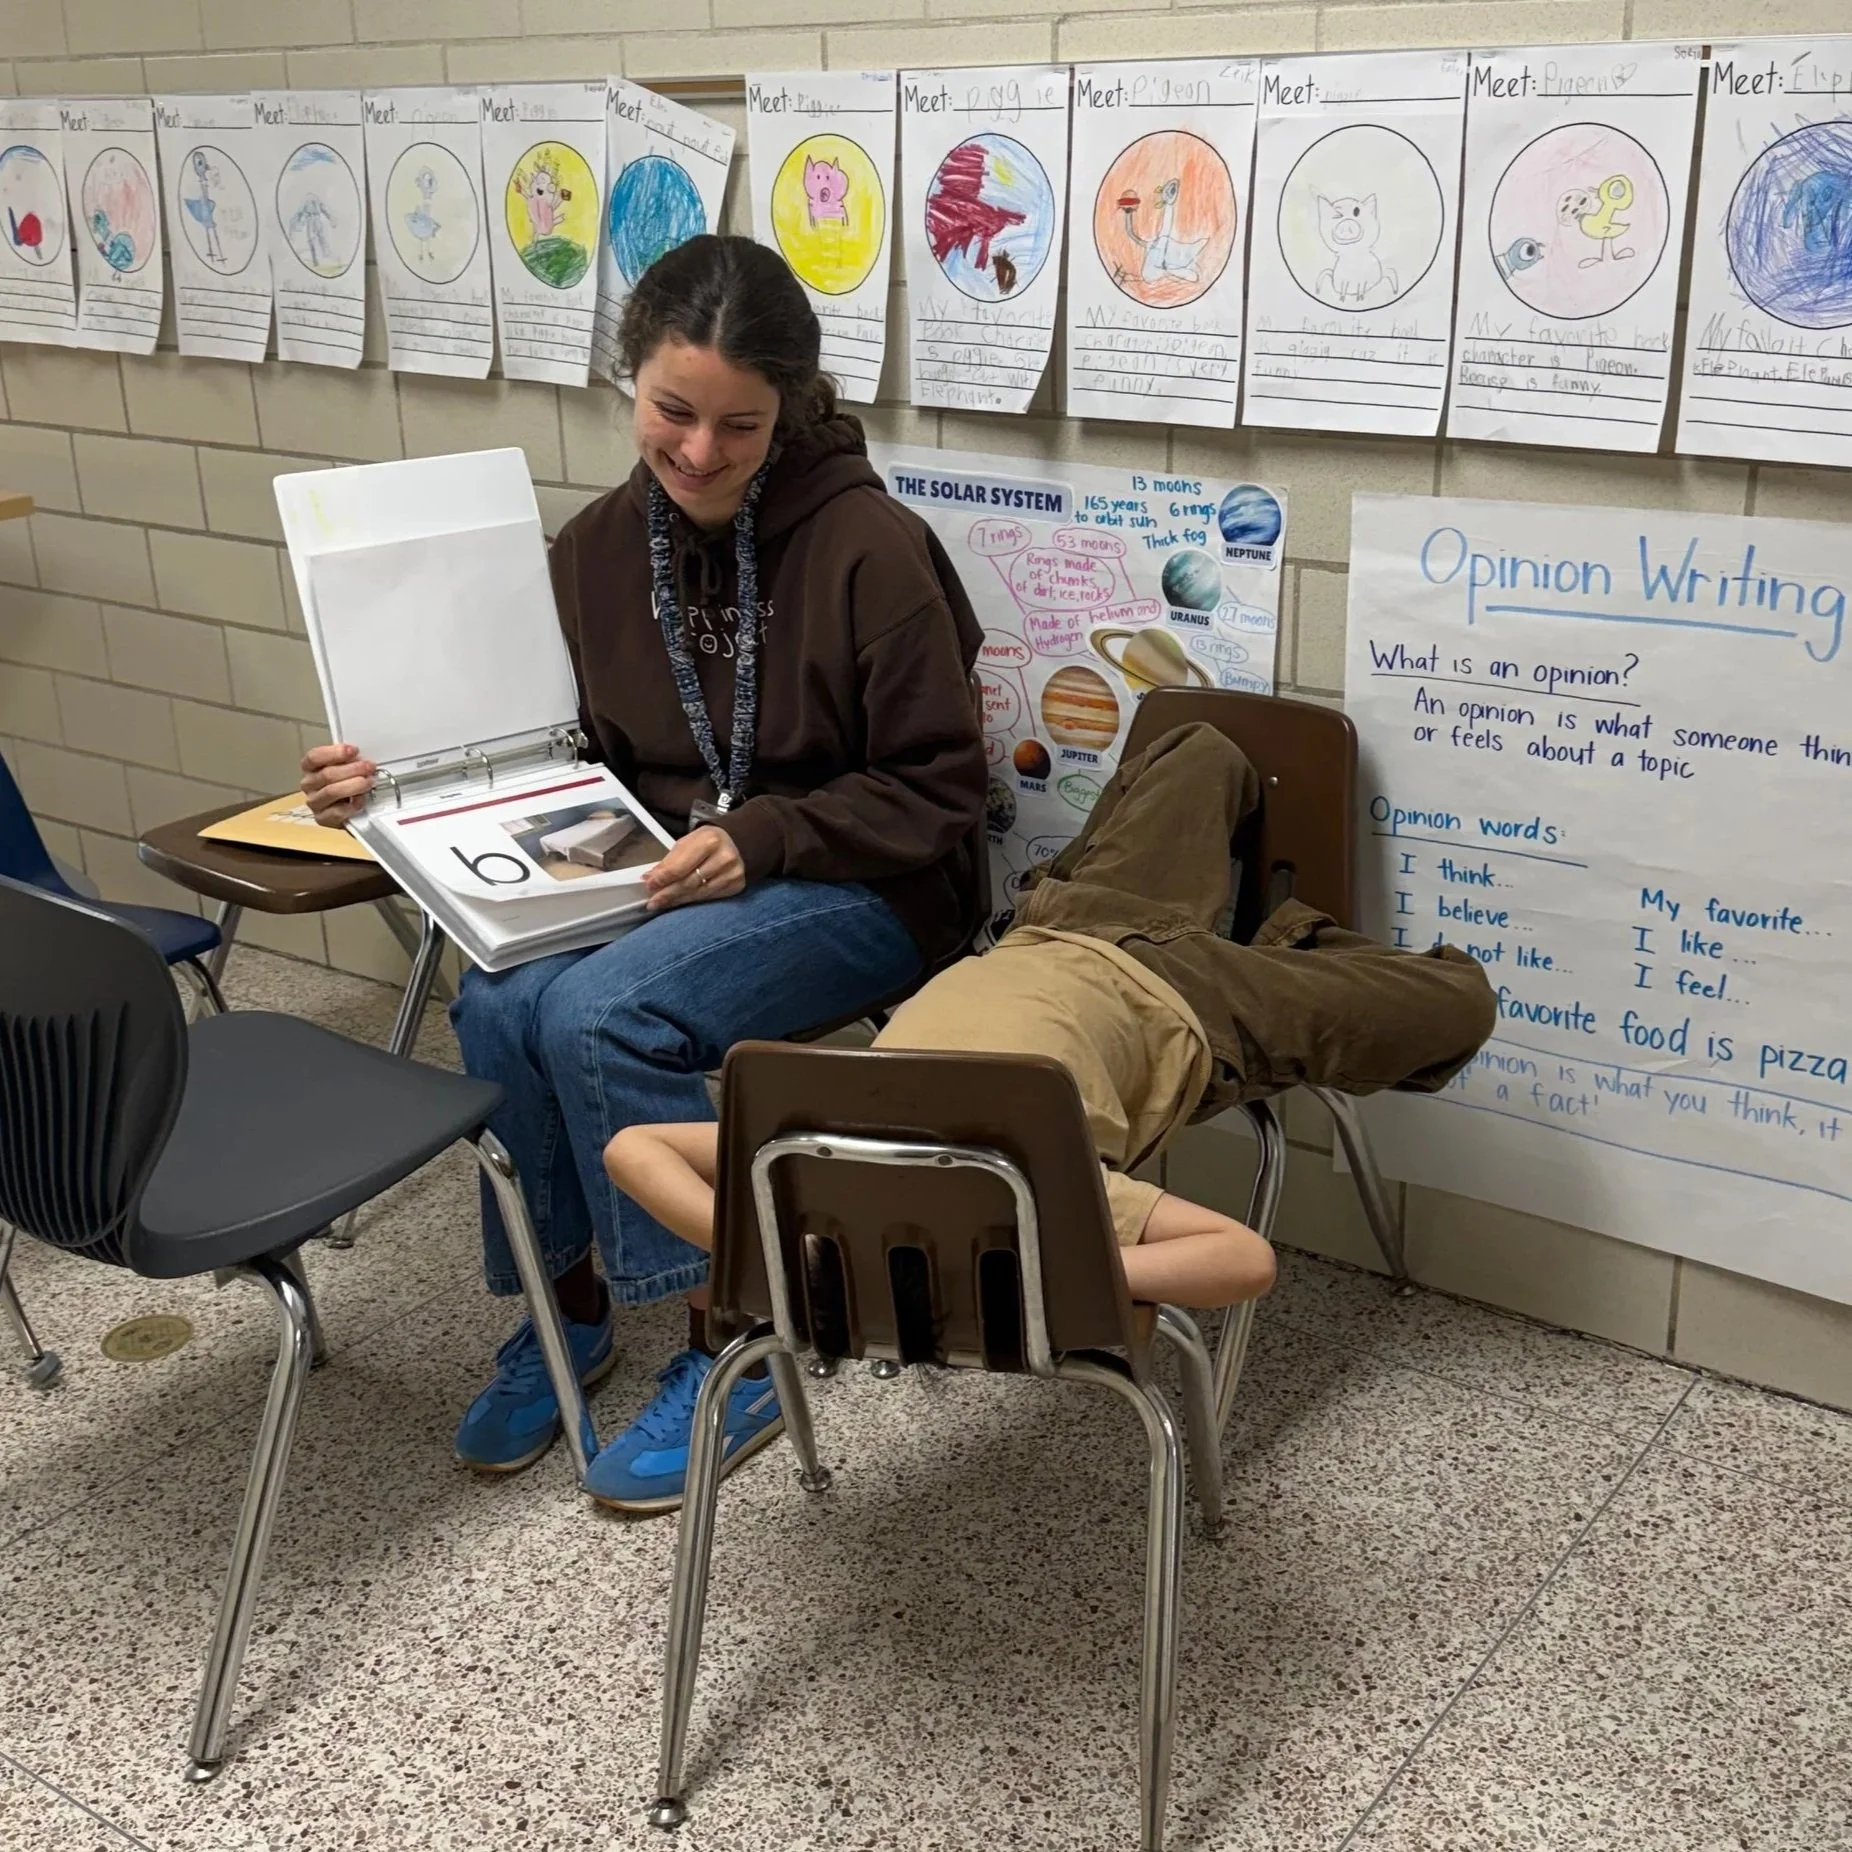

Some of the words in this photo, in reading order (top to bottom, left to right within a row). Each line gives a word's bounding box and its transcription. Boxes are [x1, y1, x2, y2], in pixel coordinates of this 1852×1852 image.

[1264, 74, 1320, 105] Meet:
[1473, 65, 1537, 98] Meet:
[1713, 61, 1783, 95] Meet:
[606, 86, 645, 123] Meet:
[749, 86, 793, 113] Meet:
[904, 84, 952, 113] Meet:
[1077, 78, 1128, 108] Meet:
[254, 103, 288, 125] Meet:
[365, 101, 399, 124] Meet:
[482, 98, 519, 122] Meet:
[1470, 311, 1513, 339] My
[895, 476, 926, 497] THE
[930, 480, 987, 503] SOLAR
[990, 487, 1063, 513] SYSTEM
[1132, 476, 1147, 491] 13
[1153, 479, 1202, 496] moons
[1084, 496, 1107, 511] 165
[1111, 499, 1148, 513] years
[1169, 502, 1178, 517] 6
[1183, 501, 1217, 525] rings
[1075, 511, 1088, 524] to
[1095, 511, 1124, 526] orbit
[1130, 516, 1158, 529] sun
[977, 526, 986, 548] 7
[990, 526, 1024, 547] rings
[1056, 534, 1077, 549] 53
[1081, 539, 1122, 554] moons
[1142, 532, 1178, 550] Thick
[1185, 529, 1207, 546] fog
[1026, 553, 1059, 574] Rings
[1064, 557, 1097, 572] made
[1226, 546, 1272, 561] NEPTUNE
[1016, 581, 1027, 593] of
[1029, 568, 1043, 581] of
[1049, 571, 1096, 588] chunks
[1421, 526, 1612, 625] Opinion
[1639, 535, 1847, 663] Writing
[1029, 614, 1061, 631] Made
[1068, 613, 1080, 627] of
[1089, 605, 1134, 623] helium
[1137, 599, 1158, 615] and
[1170, 610, 1210, 626] URANUS
[1240, 613, 1276, 630] moons
[983, 645, 1025, 661] moons
[1209, 642, 1241, 662] rings
[1369, 639, 1440, 674] What
[1453, 656, 1473, 675] is
[1489, 661, 1520, 680] an
[1533, 652, 1640, 694] opinion?
[1413, 686, 1446, 716] An
[1458, 700, 1535, 732] opinion
[1558, 711, 1577, 731] is
[1594, 714, 1654, 741] what
[1673, 728, 1778, 758] someone
[1060, 748, 1099, 764] JUPITER
[1413, 723, 1438, 743] or
[1450, 728, 1504, 753] feels
[1527, 737, 1596, 766] about
[1611, 751, 1625, 769] a
[1637, 748, 1696, 782] topic
[1019, 780, 1047, 793] MARS
[1370, 796, 1461, 837] Opinion
[1480, 816, 1566, 845] words:
[450, 846, 531, 887] b
[1399, 853, 1417, 874] I
[1394, 890, 1415, 915] I
[1640, 887, 1681, 922] My
[1391, 927, 1413, 948] I
[1467, 941, 1506, 963] not
[1632, 926, 1656, 954] I
[1634, 962, 1654, 989] I
[1496, 985, 1597, 1034] favorite
[1619, 1010, 1690, 1056] food
[1707, 1031, 1735, 1062] is
[1760, 1044, 1848, 1085] pizza
[1497, 1083, 1509, 1102] a
[1559, 1064, 1577, 1084] is
[1594, 1066, 1654, 1100] what
[1664, 1090, 1707, 1115] you
[1727, 1090, 1805, 1136] think,
